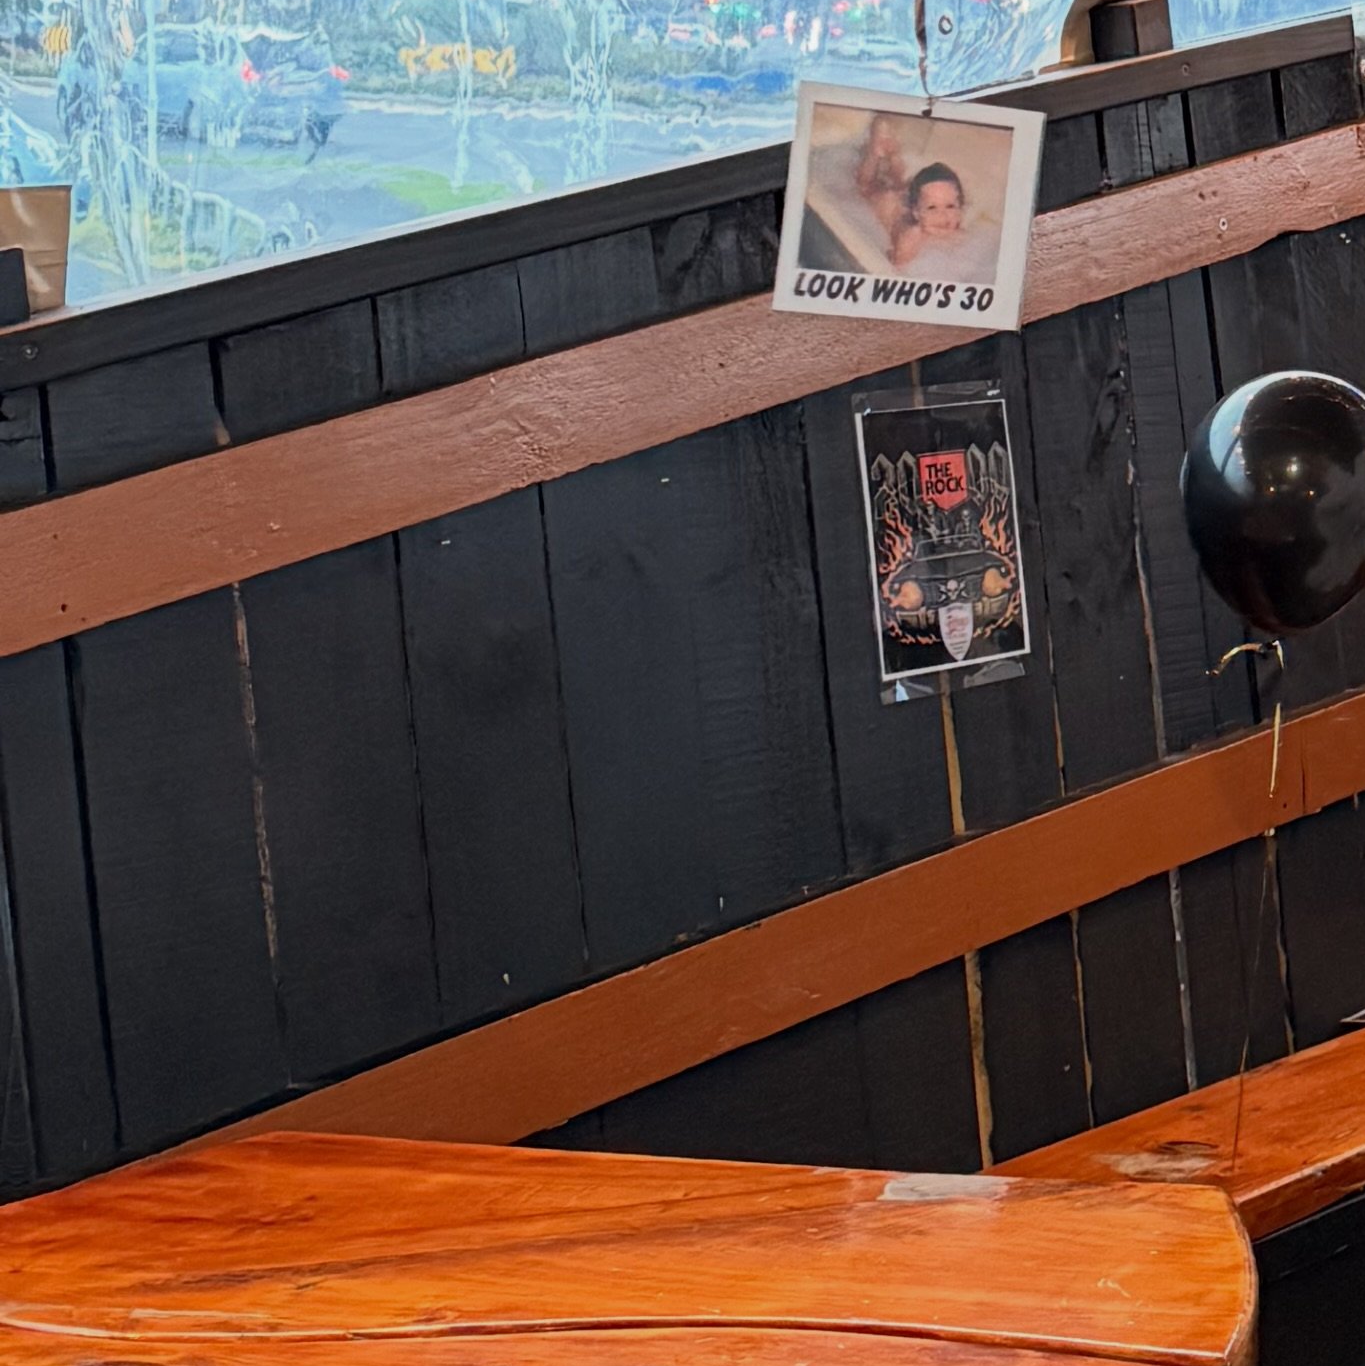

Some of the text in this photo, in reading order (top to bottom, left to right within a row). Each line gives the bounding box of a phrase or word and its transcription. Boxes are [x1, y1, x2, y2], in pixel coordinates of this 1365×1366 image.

[794, 272, 994, 312] LOOK WHO'S 30
[926, 462, 953, 479] THE
[925, 476, 965, 495] ROCK
